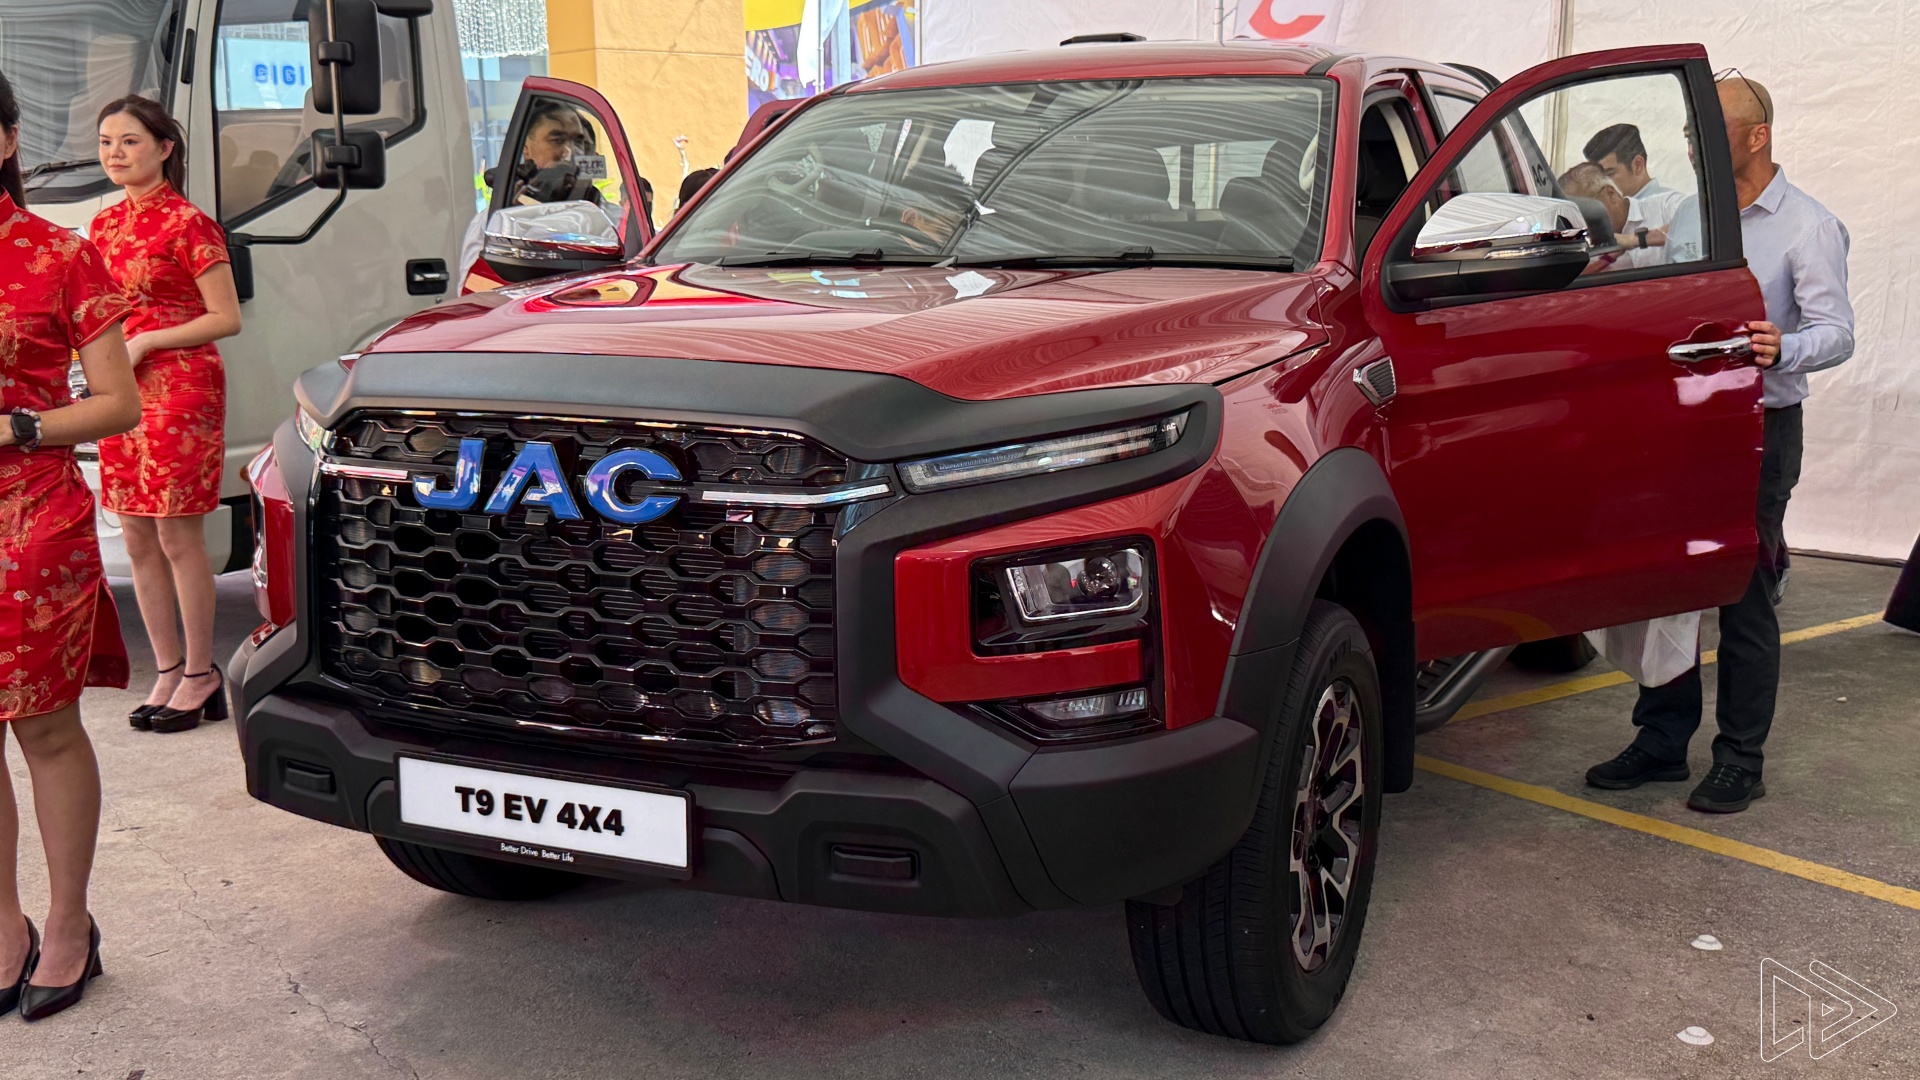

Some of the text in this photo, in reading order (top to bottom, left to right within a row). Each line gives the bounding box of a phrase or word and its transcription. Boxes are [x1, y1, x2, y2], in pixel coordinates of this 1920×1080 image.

[1161, 422, 1176, 432] JAC
[412, 437, 684, 524] JAC
[455, 786, 625, 836] T9 EV 4X4
[501, 842, 575, 863] Better Drive Better Life
